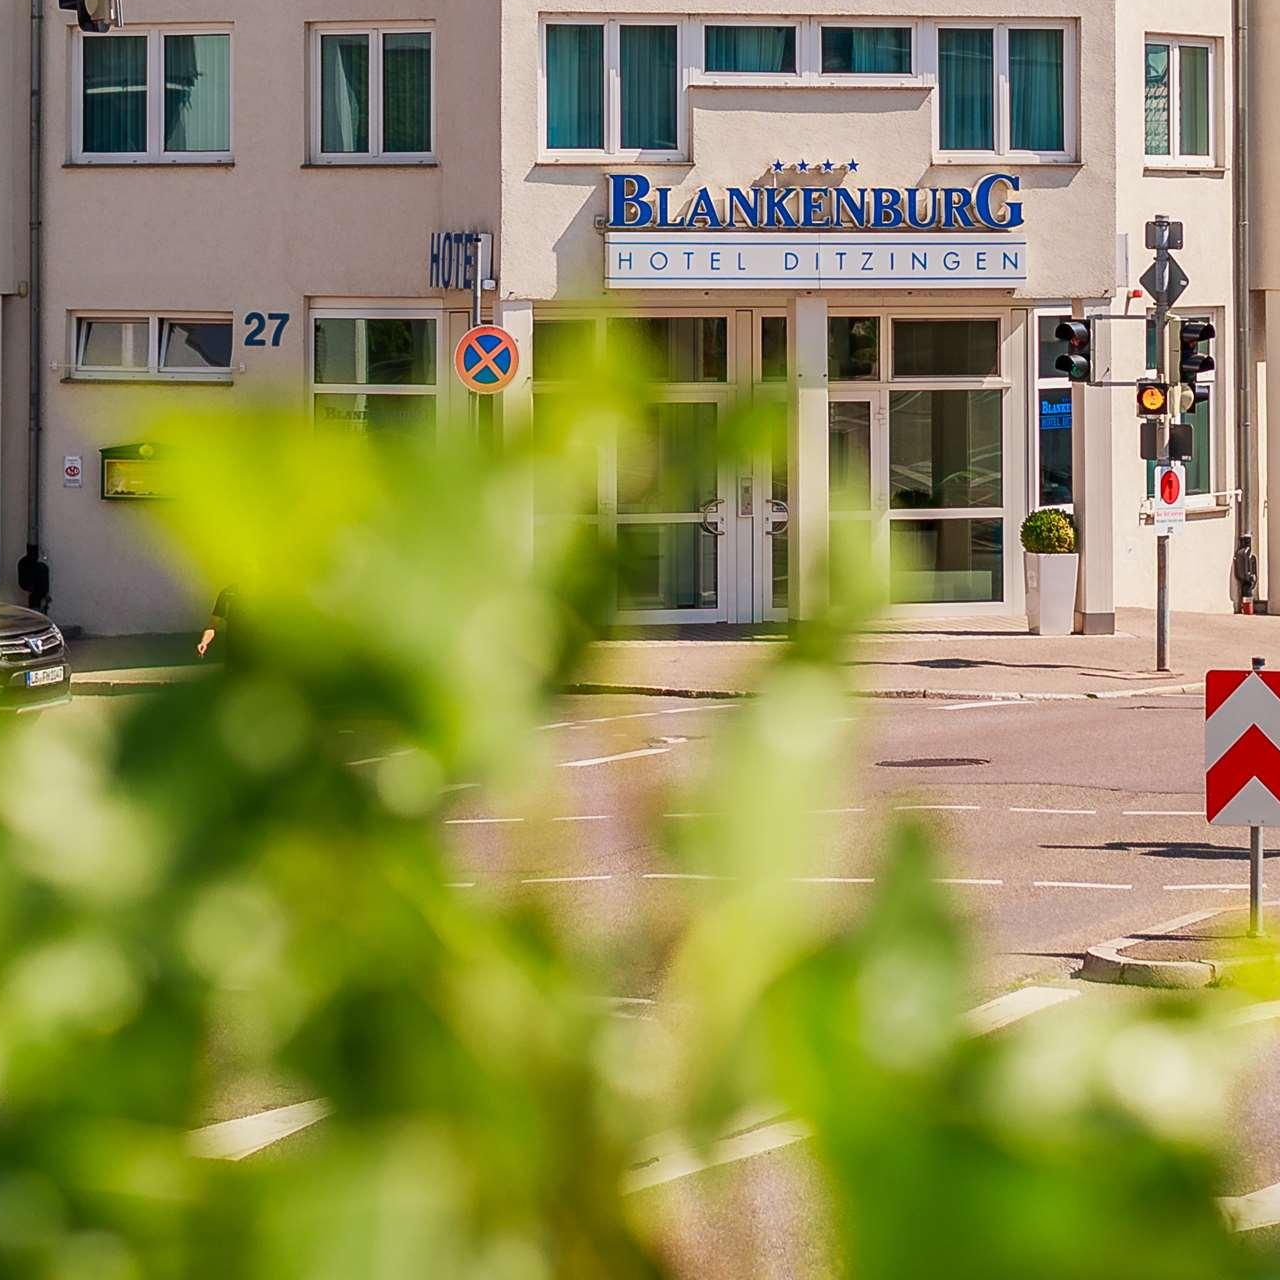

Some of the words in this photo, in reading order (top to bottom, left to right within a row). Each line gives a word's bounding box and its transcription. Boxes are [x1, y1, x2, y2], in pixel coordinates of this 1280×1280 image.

[607, 173, 1024, 229] BLANKENBURG
[430, 232, 482, 289] HOTE
[618, 251, 746, 271] HOTEL
[784, 251, 1019, 271] DITZINGEN
[244, 311, 290, 347] 27
